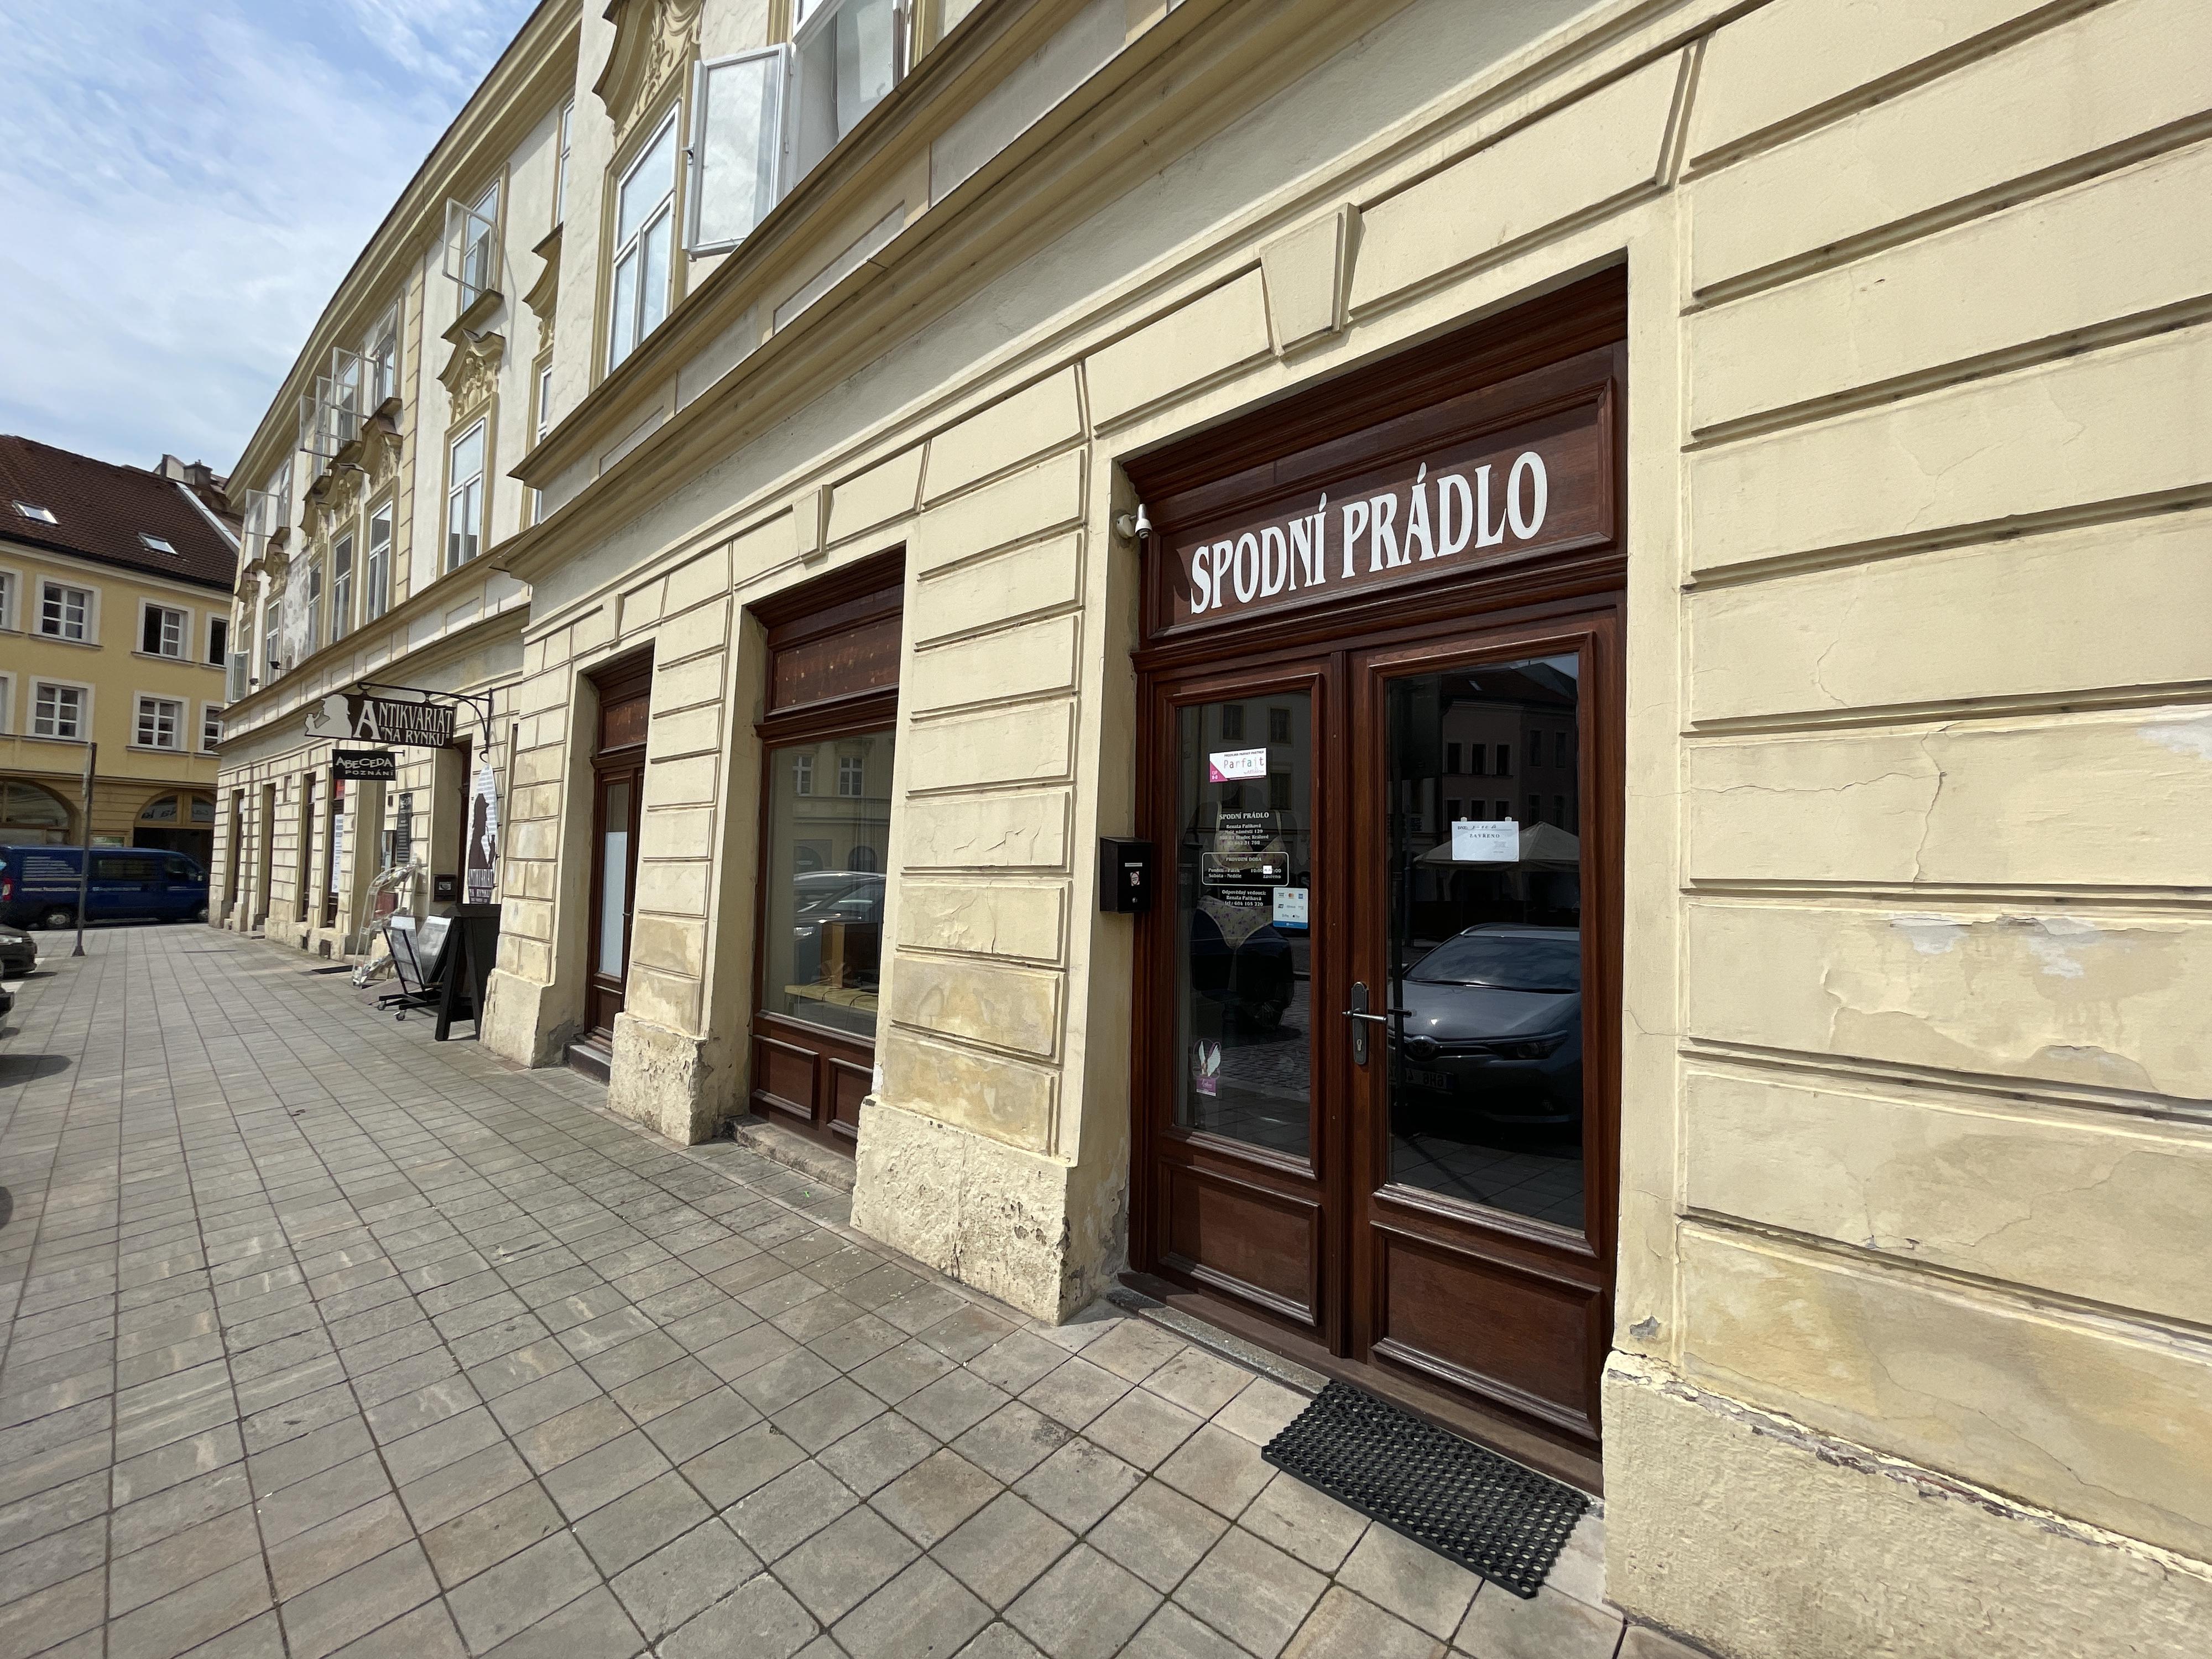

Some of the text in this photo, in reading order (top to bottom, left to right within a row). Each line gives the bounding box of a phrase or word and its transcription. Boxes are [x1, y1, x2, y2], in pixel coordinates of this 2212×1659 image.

[1190, 451, 1548, 615] SPODNÍ PRÁDLO
[353, 700, 453, 740] ANTIKVARIÁT
[335, 757, 394, 769] ABECEDA
[1224, 757, 1264, 769] Parfait
